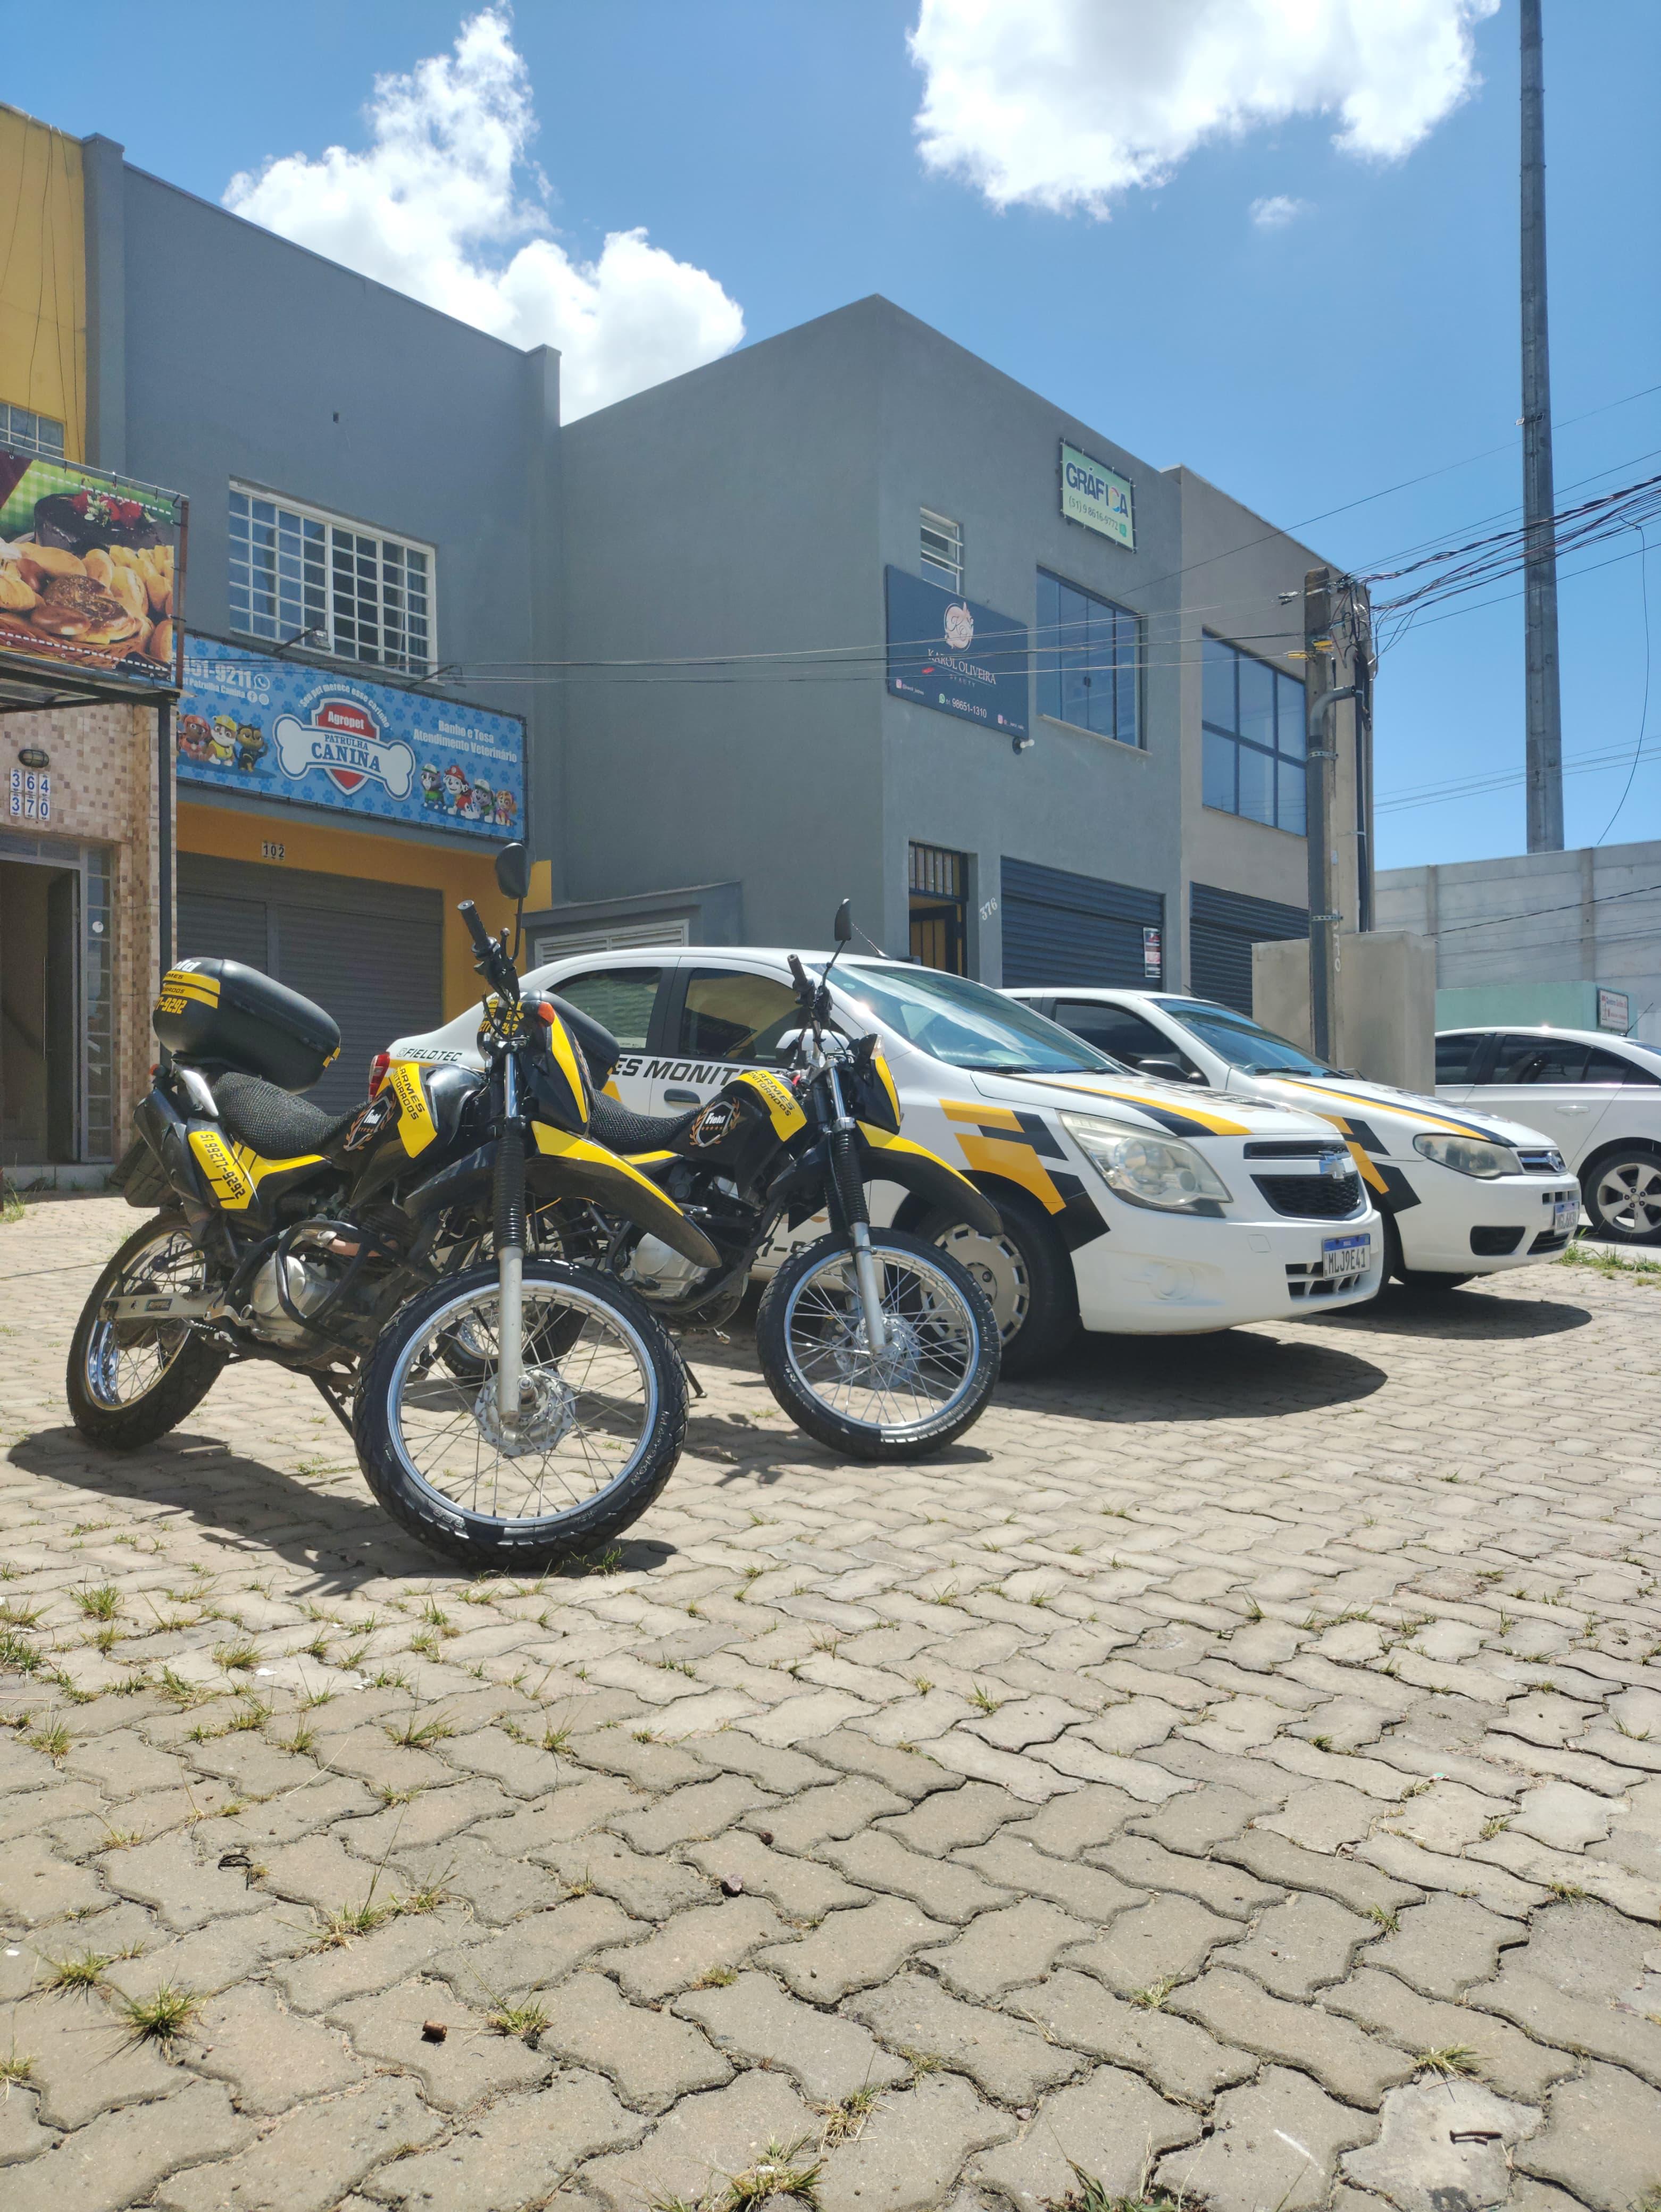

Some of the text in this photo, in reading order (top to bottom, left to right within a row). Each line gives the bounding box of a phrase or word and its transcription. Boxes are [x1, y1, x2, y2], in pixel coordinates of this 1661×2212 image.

[958, 661, 996, 685] OLIVEIRA
[323, 683, 350, 693] merece
[352, 688, 369, 702] esse
[328, 711, 365, 730] Agropet
[438, 719, 494, 744] Banho e Tosa
[324, 734, 369, 751] PATRULHA
[413, 728, 518, 763] Atendimento Veterinário
[311, 742, 381, 773] CANINA
[12, 773, 49, 793] 364
[12, 797, 48, 816] 370
[263, 845, 285, 858] 102
[980, 897, 998, 920] 376
[204, 1143, 246, 1200] 99277-9292
